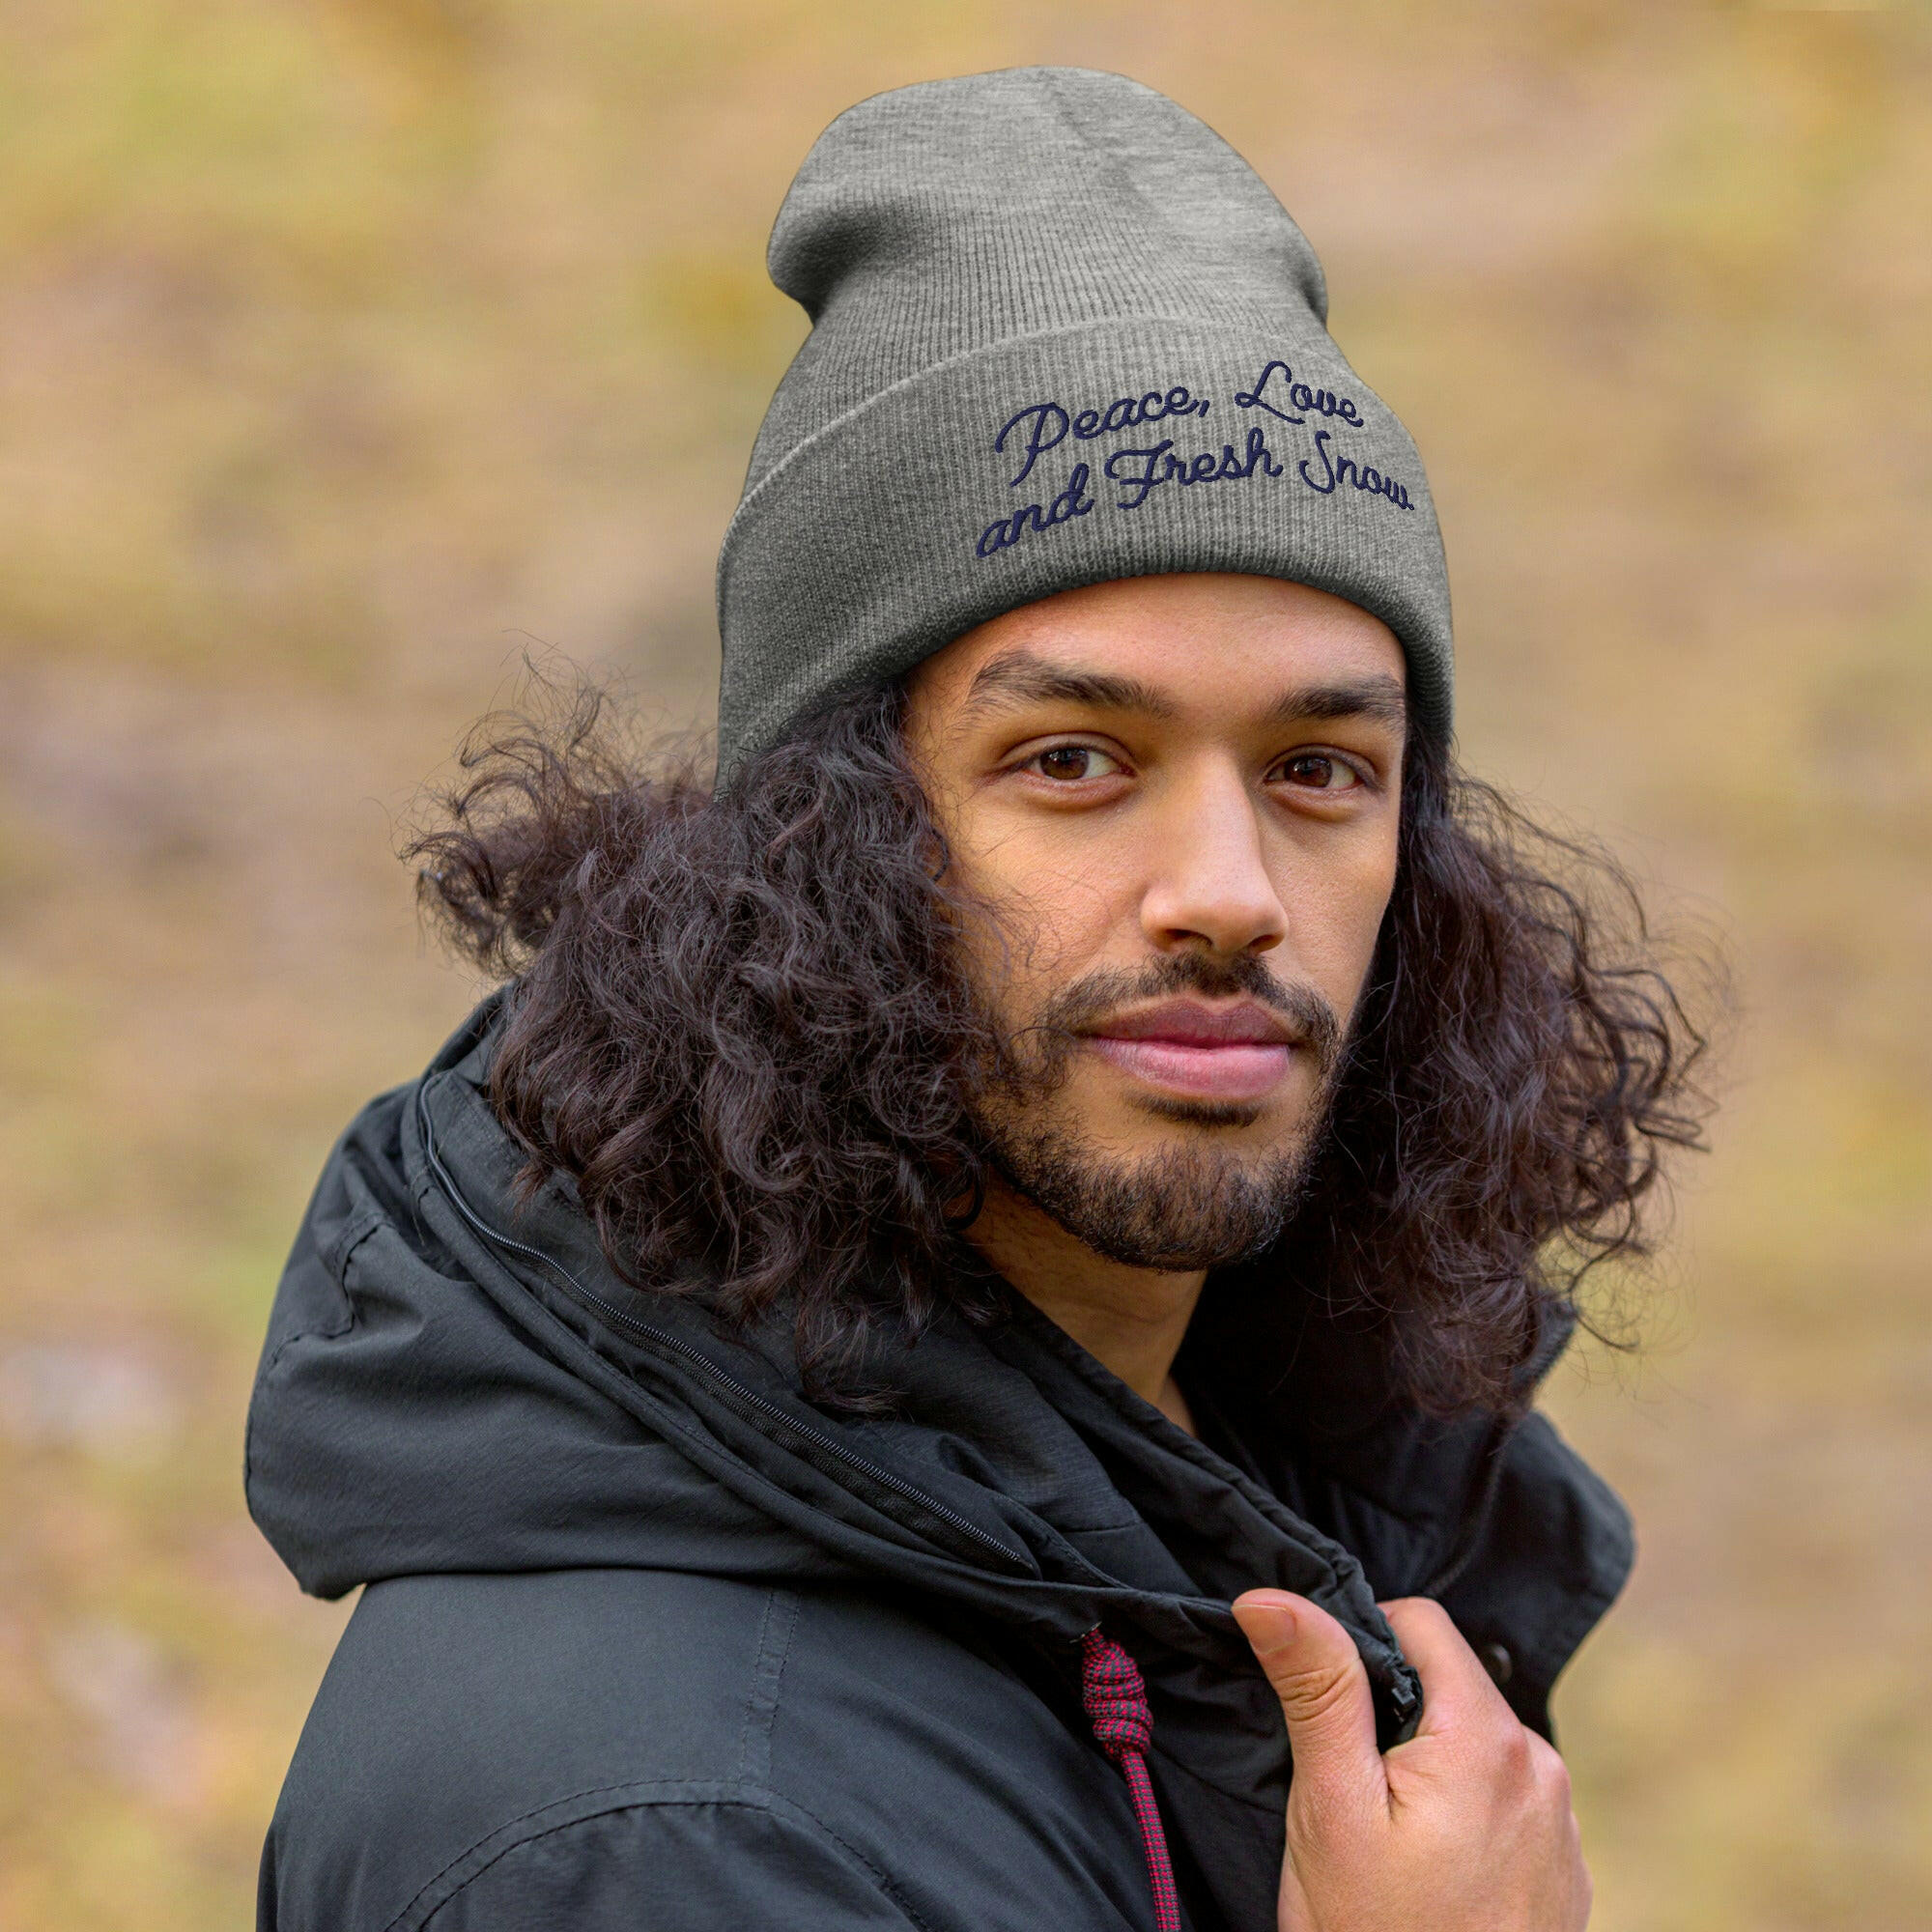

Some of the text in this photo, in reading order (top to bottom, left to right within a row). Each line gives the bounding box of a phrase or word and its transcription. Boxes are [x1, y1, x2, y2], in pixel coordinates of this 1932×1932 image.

[994, 360, 1364, 487] Peace, Love
[976, 463, 1094, 558] and
[1104, 427, 1284, 510] Fresh
